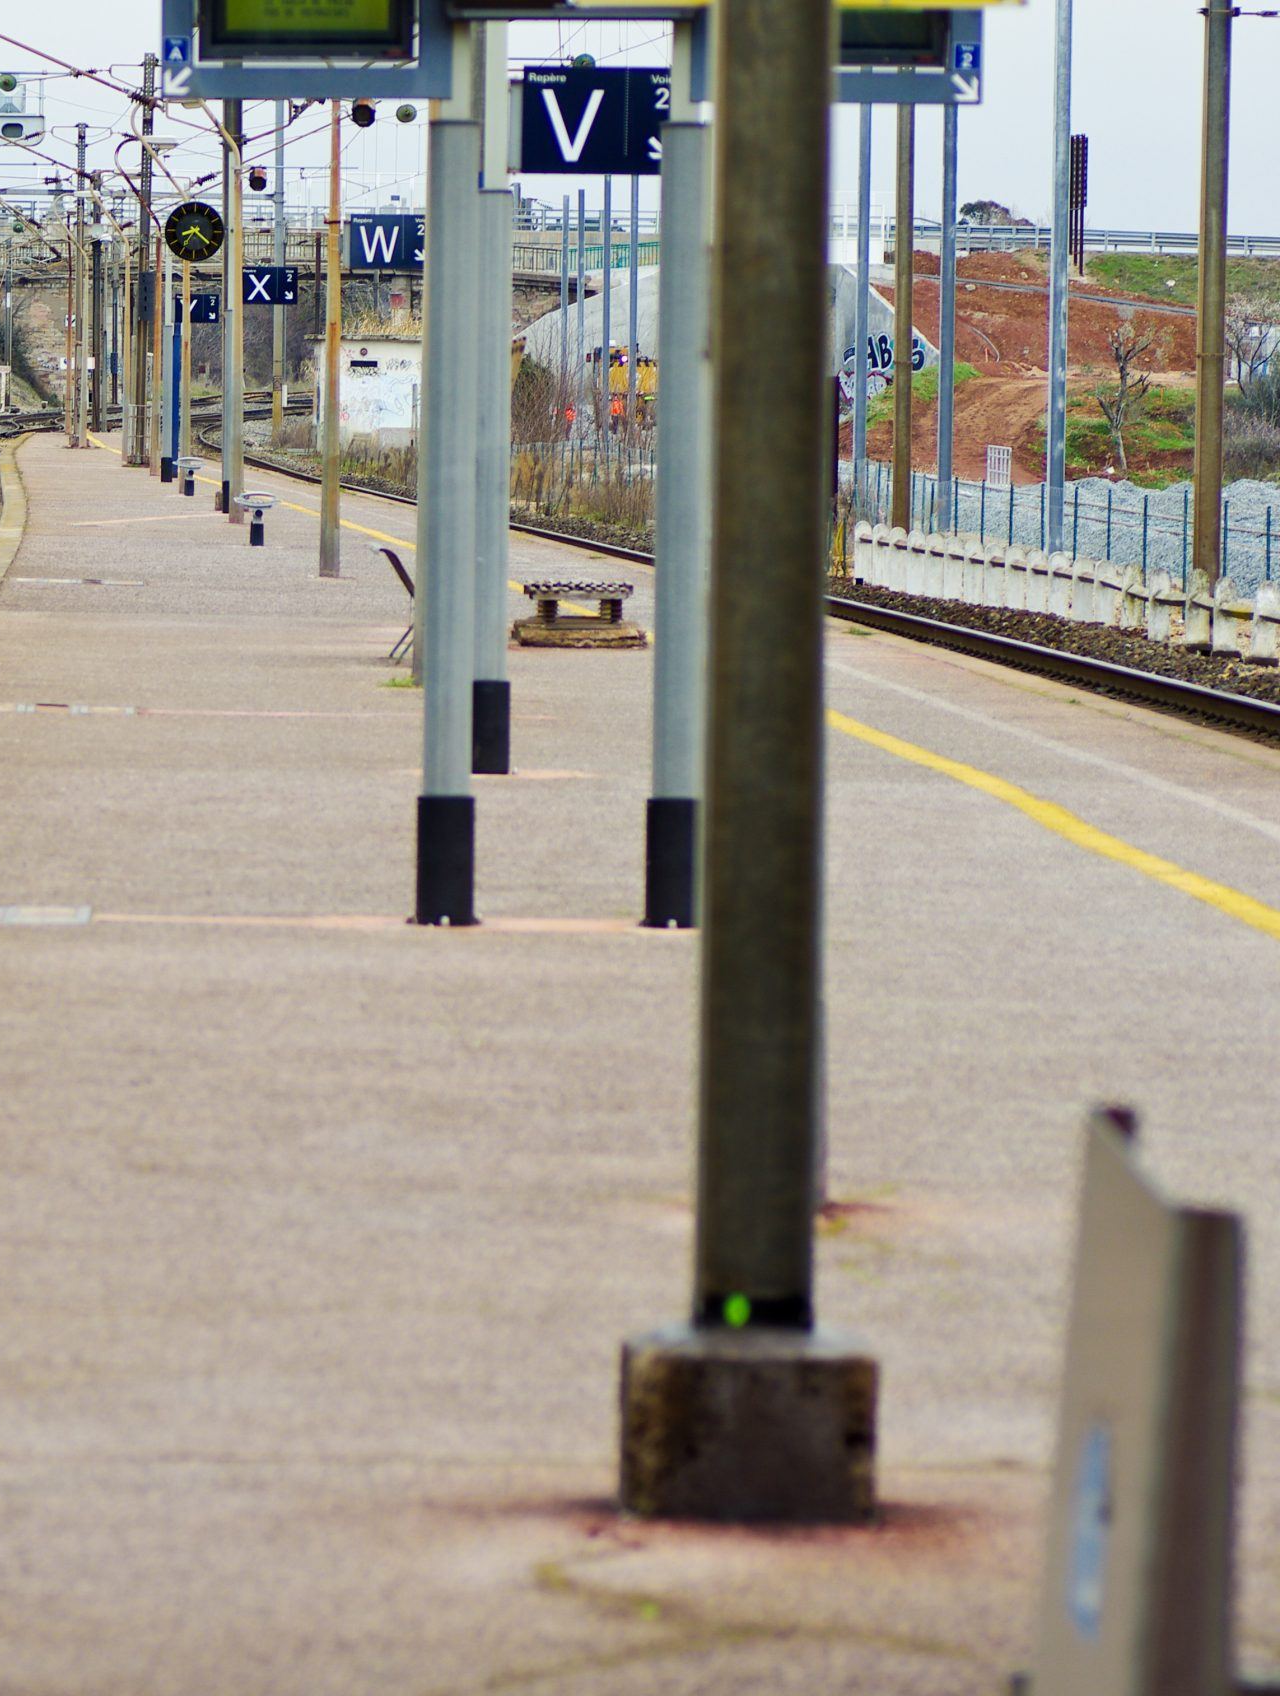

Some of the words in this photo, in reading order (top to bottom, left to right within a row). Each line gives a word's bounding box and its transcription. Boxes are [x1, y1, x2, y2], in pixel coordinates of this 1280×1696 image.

[962, 52, 973, 68] 2
[528, 72, 567, 84] Repère
[651, 74, 671, 84] Voi
[542, 88, 605, 162] V
[654, 87, 670, 110] 2
[359, 225, 400, 264] W
[416, 224, 425, 236] 2
[247, 274, 271, 301] X
[286, 274, 293, 282] 2
